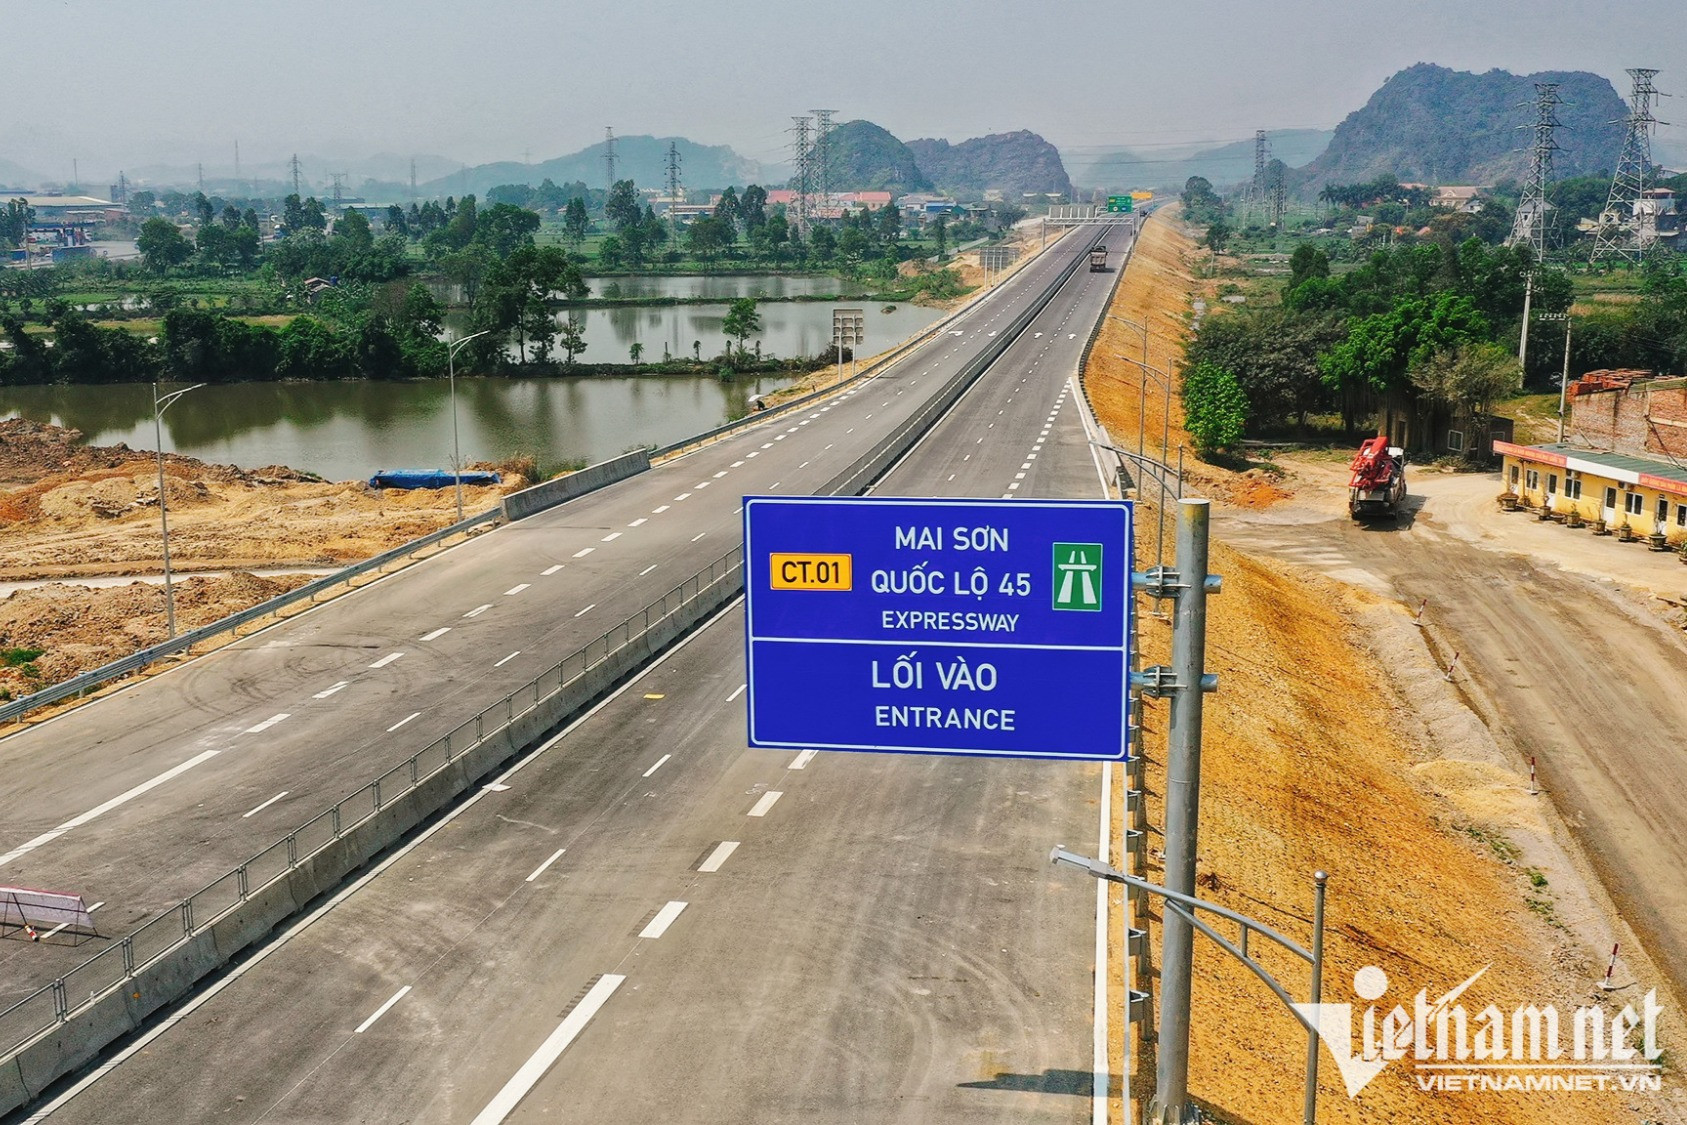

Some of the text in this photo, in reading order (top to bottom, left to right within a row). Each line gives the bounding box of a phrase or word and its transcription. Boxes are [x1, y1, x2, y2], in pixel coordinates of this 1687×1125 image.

[896, 525, 1008, 551] MAI SƠN
[782, 561, 839, 583] CT.01
[872, 561, 1030, 600] QUỐC LỘ 45
[883, 611, 1019, 631] EXPRESSWAY
[872, 651, 997, 691] LỐI VÀO
[876, 706, 1015, 730] ENTRANCE
